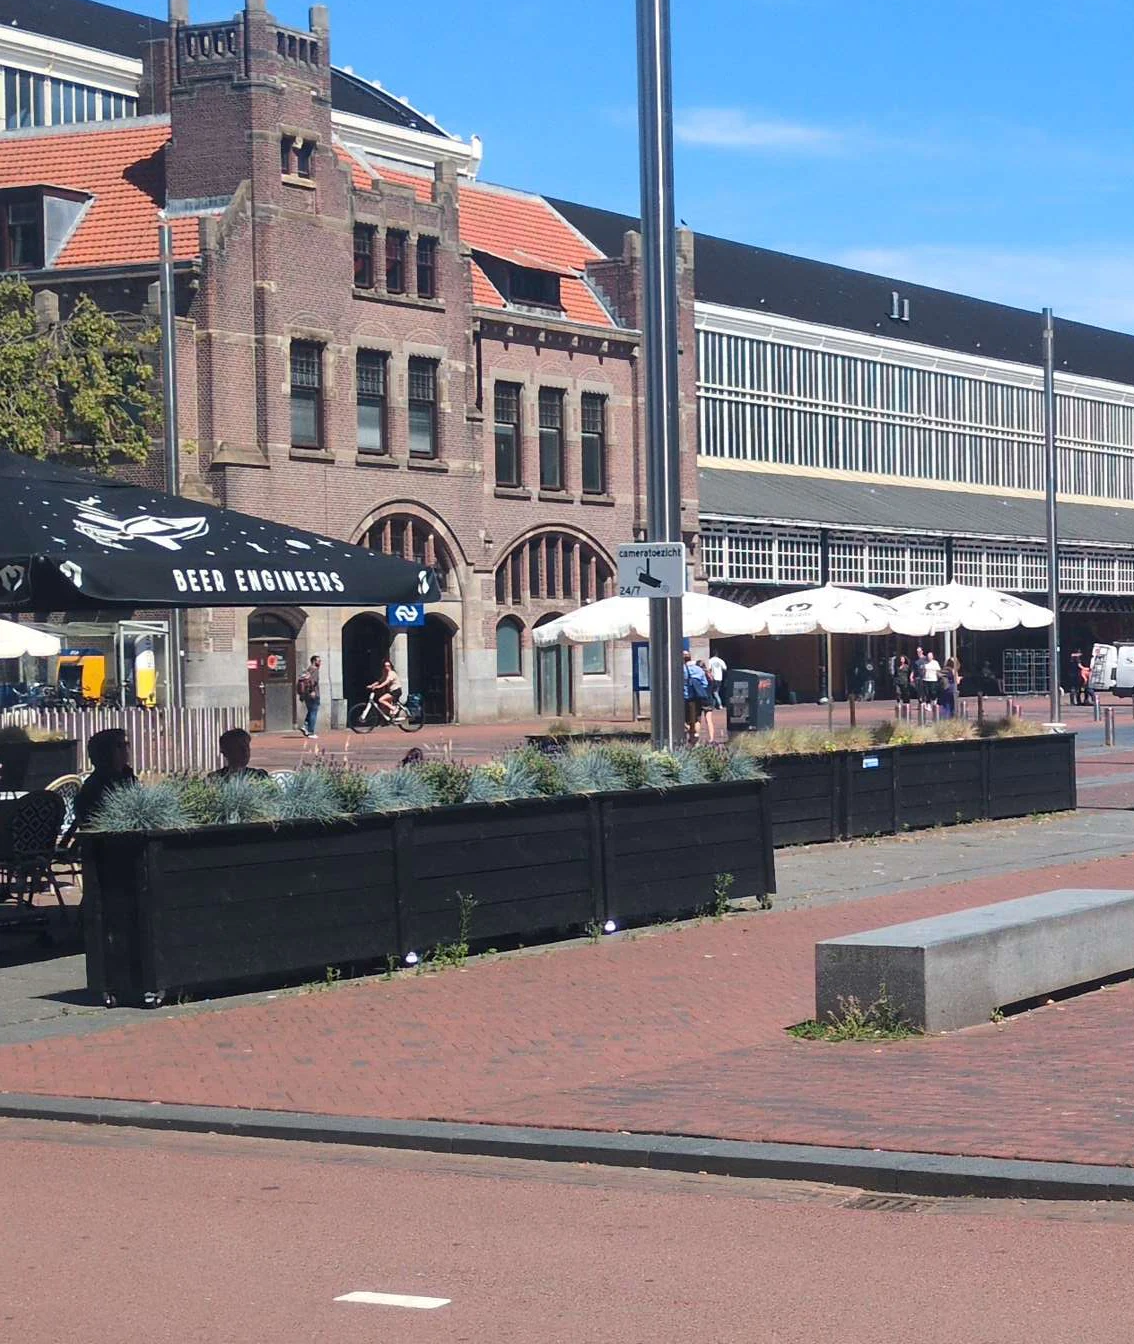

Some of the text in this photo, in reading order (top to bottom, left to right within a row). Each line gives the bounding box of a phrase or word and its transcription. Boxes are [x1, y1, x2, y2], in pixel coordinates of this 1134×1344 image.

[619, 548, 682, 558] cameratoezicht
[172, 569, 345, 592] BEER ENGINEERS
[620, 586, 641, 596] 24/7
